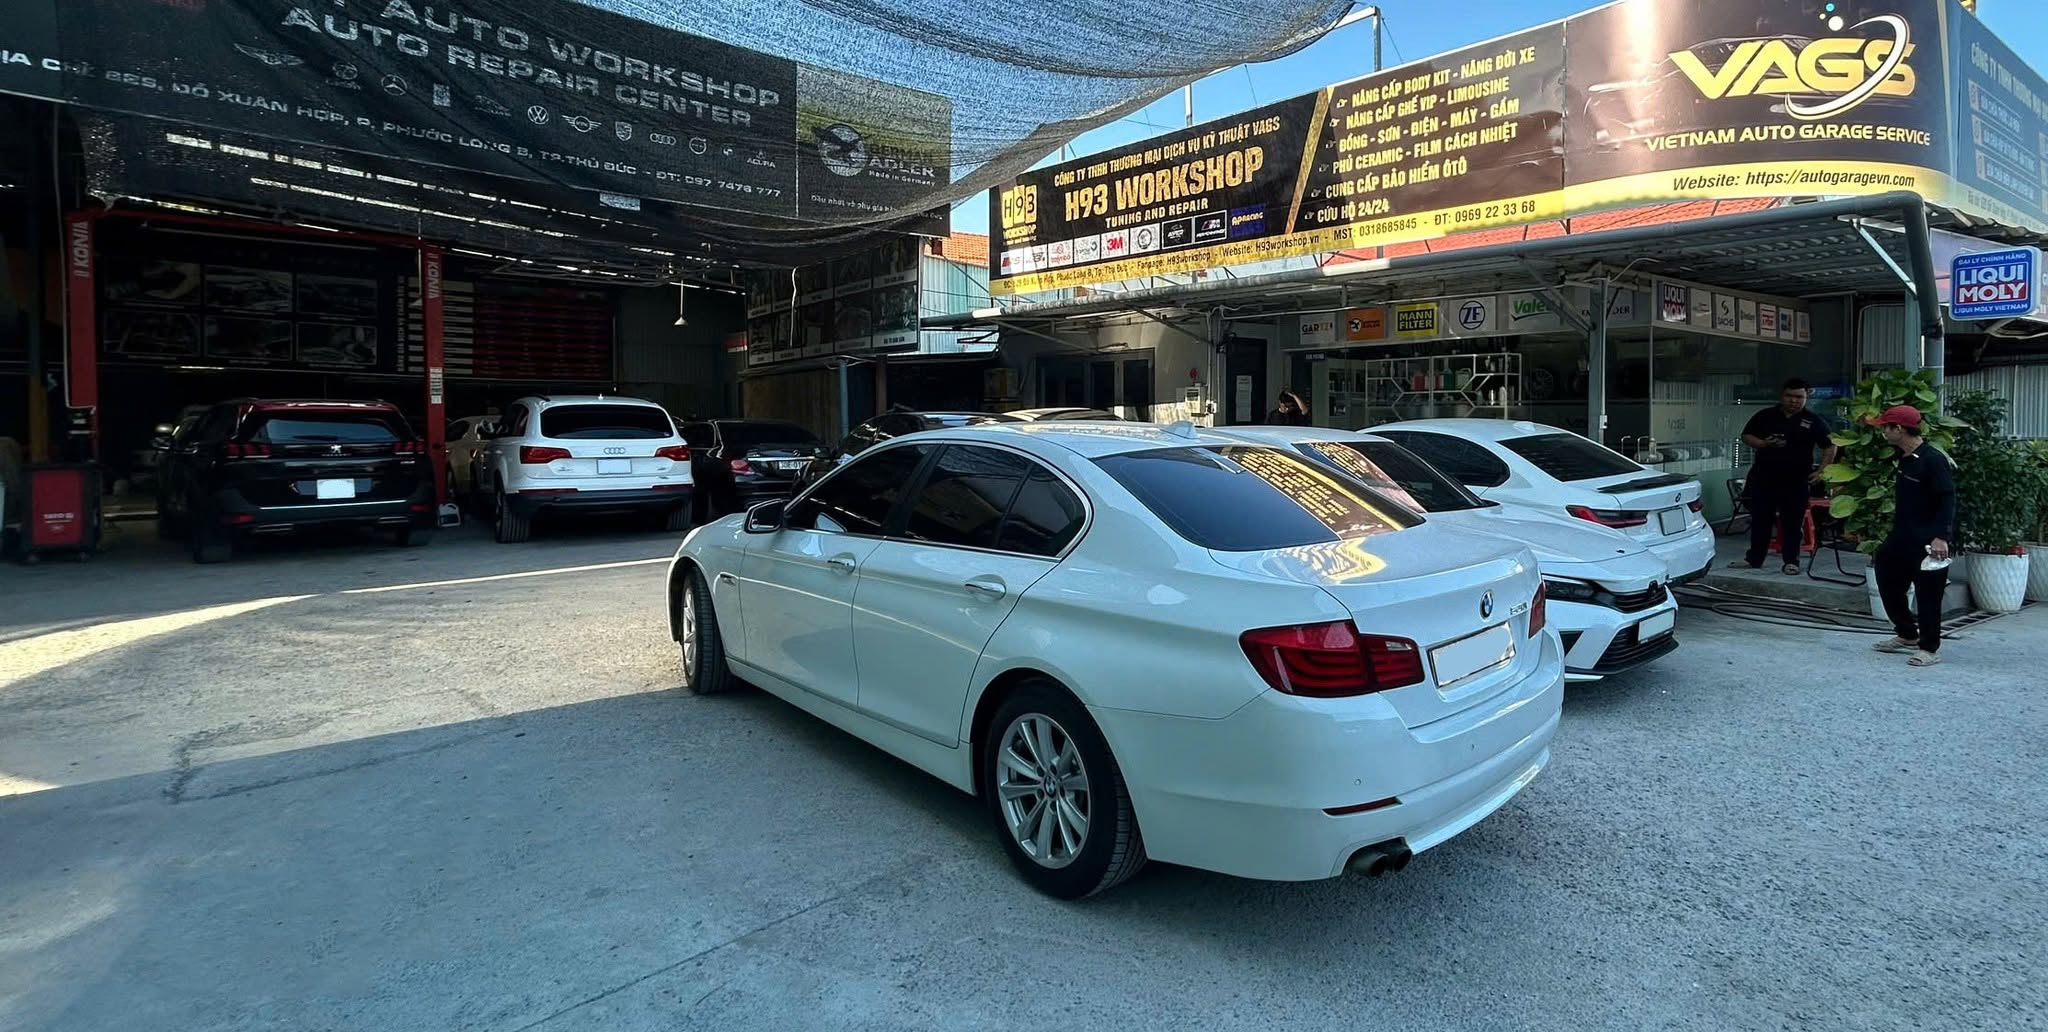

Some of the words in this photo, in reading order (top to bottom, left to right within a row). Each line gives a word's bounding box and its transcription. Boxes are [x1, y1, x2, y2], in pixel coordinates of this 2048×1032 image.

[281, 7, 429, 57] AUTO
[448, 45, 600, 97] REPAIR
[615, 85, 752, 128] CENTER
[380, 0, 530, 51] AUTO
[545, 36, 780, 107] WORKSHOP
[1668, 37, 1916, 99] VAGS
[1352, 87, 1379, 108] NÂNG
[1382, 80, 1402, 103] CẤP
[1405, 74, 1431, 95] BODY
[1433, 68, 1451, 87] KIT
[1461, 58, 1493, 78] NÂNG
[1495, 53, 1516, 70] ĐỜI
[1519, 46, 1535, 62] XE
[1346, 109, 1373, 130] NÂNG
[1375, 101, 1395, 123] CẤP
[1398, 97, 1418, 117] GHẾ
[1420, 93, 1437, 111] VIP
[1447, 77, 1510, 105] LIMOUSINE
[0, 50, 32, 66] ỊA
[217, 89, 288, 113] XUÂN
[459, 136, 511, 153] LONG
[604, 160, 637, 175] ĐỨC
[656, 171, 681, 183] ĐT:
[685, 175, 712, 187] 097
[756, 186, 781, 197] 777
[1377, 124, 1400, 145] SƠN
[1411, 117, 1438, 138] ĐIỆN
[1450, 107, 1478, 128] MÁY
[1644, 128, 1734, 152] VIETNAM
[1739, 125, 1796, 142] AUTO
[1799, 122, 1873, 141] GARAGE
[1875, 125, 1931, 147] SERVICE
[1054, 172, 1075, 187] CÔNG
[1076, 166, 1086, 181] TY
[1087, 161, 1108, 179] TNHH
[1144, 149, 1162, 166] MẠI
[1164, 142, 1185, 161] DỊCH
[1188, 138, 1200, 155] VỤ
[1218, 123, 1250, 144] THUẬT
[1253, 115, 1281, 136] VAGS
[1355, 147, 1403, 170] CERAMIC
[1414, 138, 1441, 158] FILM
[1445, 130, 1477, 152] CÁCH
[1480, 122, 1518, 146] NHIỆT
[901, 175, 936, 187] Germany
[1065, 183, 1109, 222] H93
[1115, 145, 1264, 211] WORKSHOP
[1325, 180, 1354, 198] CUNG
[1356, 170, 1380, 193] CẤP
[1382, 167, 1405, 188] BẢO
[1442, 158, 1467, 177] ÔTÔ
[1672, 173, 1740, 192] Website:
[1745, 169, 1915, 188] https://autogaragevn.com
[1004, 193, 1035, 219] H93
[1105, 210, 1141, 229] TUNING
[1144, 205, 1165, 221] AND
[1168, 197, 1209, 216] REPAIR
[1317, 202, 1339, 223] CỨU
[1340, 203, 1355, 221] HỘ
[1358, 198, 1390, 217] 24/24
[1107, 236, 1123, 251] 3M
[1137, 256, 1165, 273] Fanpage:
[1167, 251, 1211, 266] H93workshop
[1222, 244, 1253, 257] Website:
[1255, 234, 1320, 252] H93workshop.vn
[1333, 228, 1356, 241] MST:
[1359, 217, 1418, 237] 0318685845
[1434, 213, 1451, 226] ĐT:
[1455, 208, 1481, 223] 0969
[1485, 205, 1499, 219] 22
[1503, 202, 1517, 216] 33
[1521, 200, 1535, 213] 68
[1960, 264, 2024, 285] LIQUI
[1664, 284, 1685, 303] LIQUI
[1959, 282, 2025, 303] MOLY
[1400, 311, 1432, 321] MANN
[1462, 306, 1481, 324] ZF
[1954, 306, 1973, 314] LIQUI
[1974, 305, 1993, 313] MOLY
[1995, 303, 2028, 311] VIETNAM
[1400, 319, 1432, 330] FILTER
